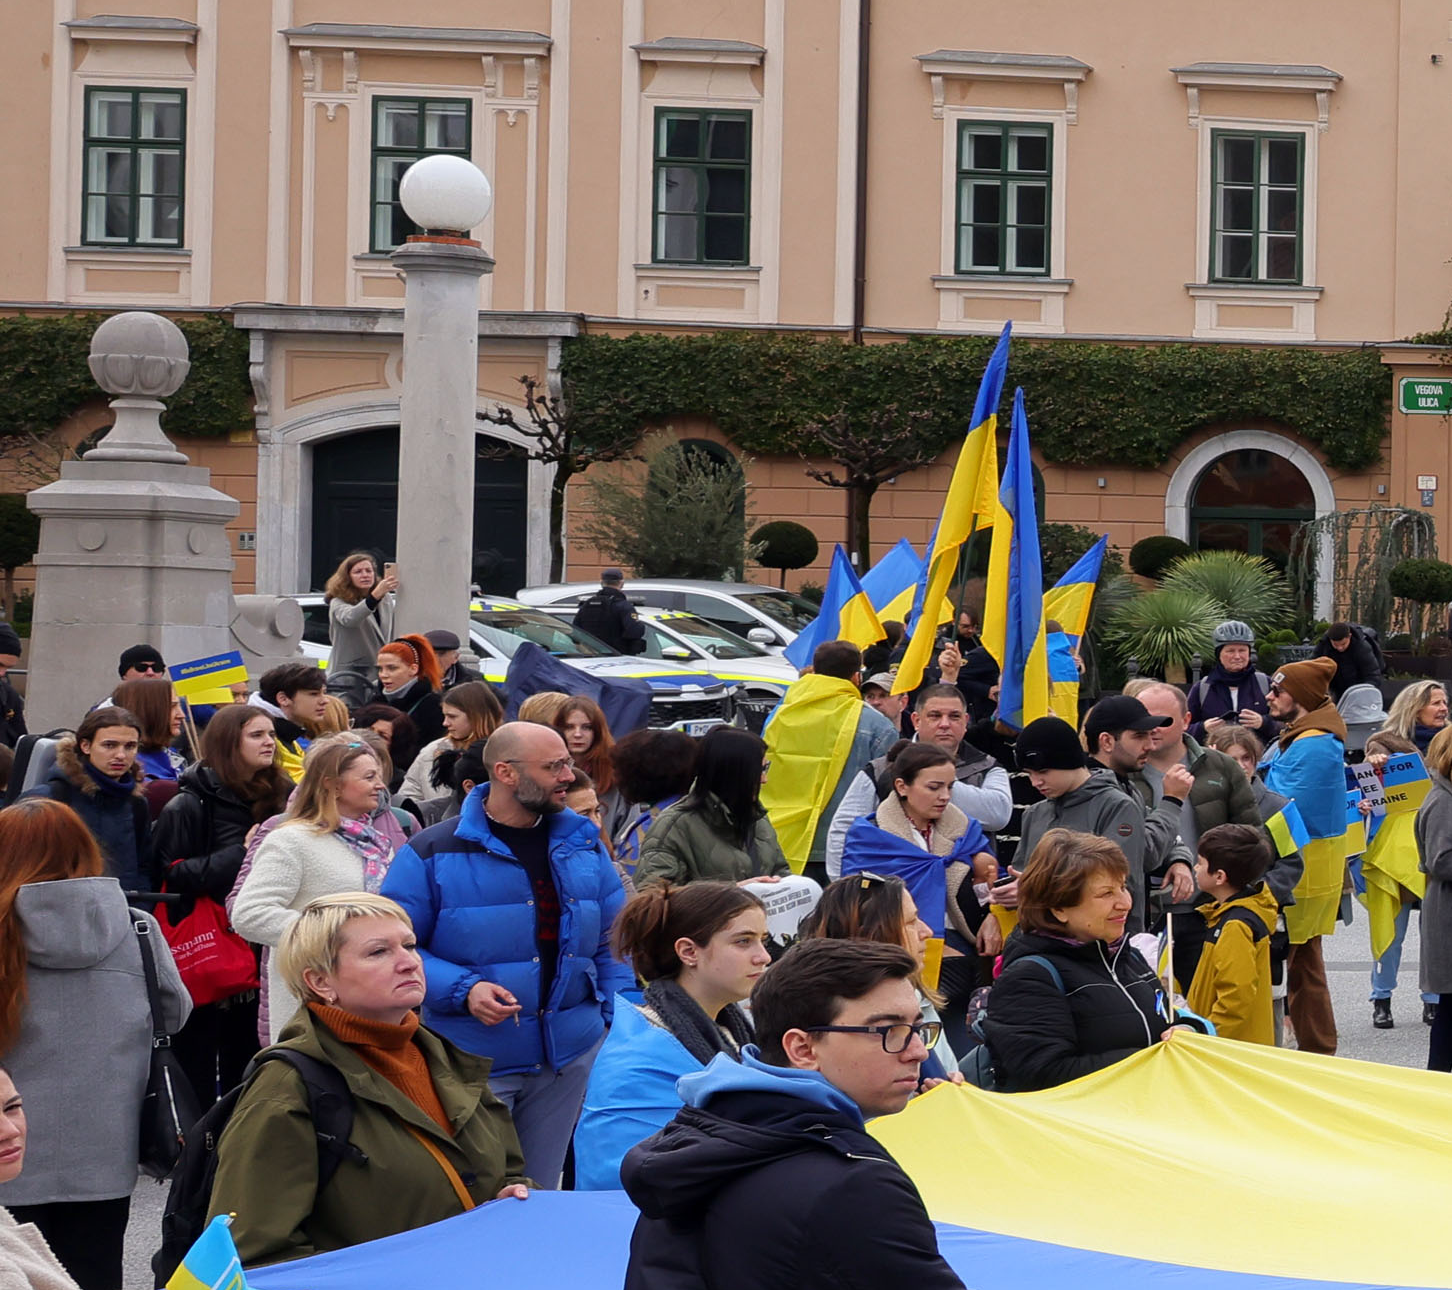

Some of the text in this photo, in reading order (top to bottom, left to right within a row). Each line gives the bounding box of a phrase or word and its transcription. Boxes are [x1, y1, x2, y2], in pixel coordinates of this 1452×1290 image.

[1414, 384, 1443, 395] VEGOVA
[1418, 397, 1439, 407] ULICA
[1390, 761, 1414, 775] FOR
[1371, 792, 1409, 807] RAINE
